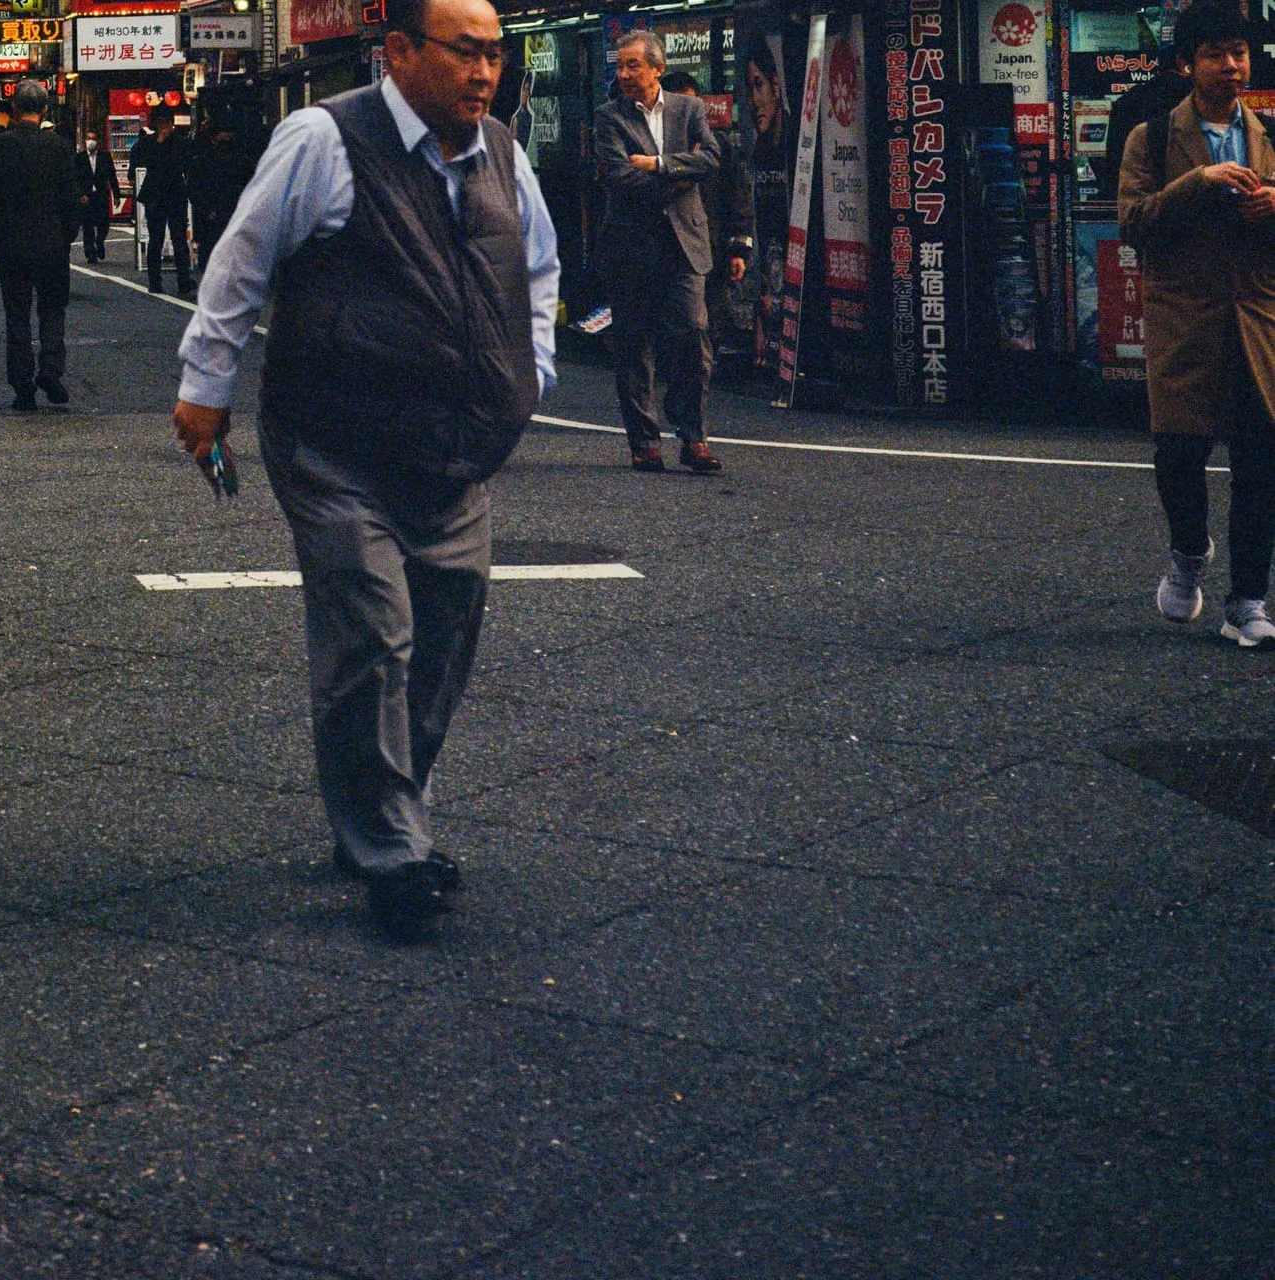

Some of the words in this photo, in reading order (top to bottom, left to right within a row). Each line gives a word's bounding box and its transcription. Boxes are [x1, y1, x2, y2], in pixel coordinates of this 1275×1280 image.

[1, 22, 59, 42] 買取り
[94, 26, 163, 37] 昭和30年創業
[995, 53, 1036, 66] Japan.
[1096, 55, 1159, 71] いらっし
[992, 69, 1038, 80] Tax-free
[919, 241, 947, 404] 新宿西口本店
